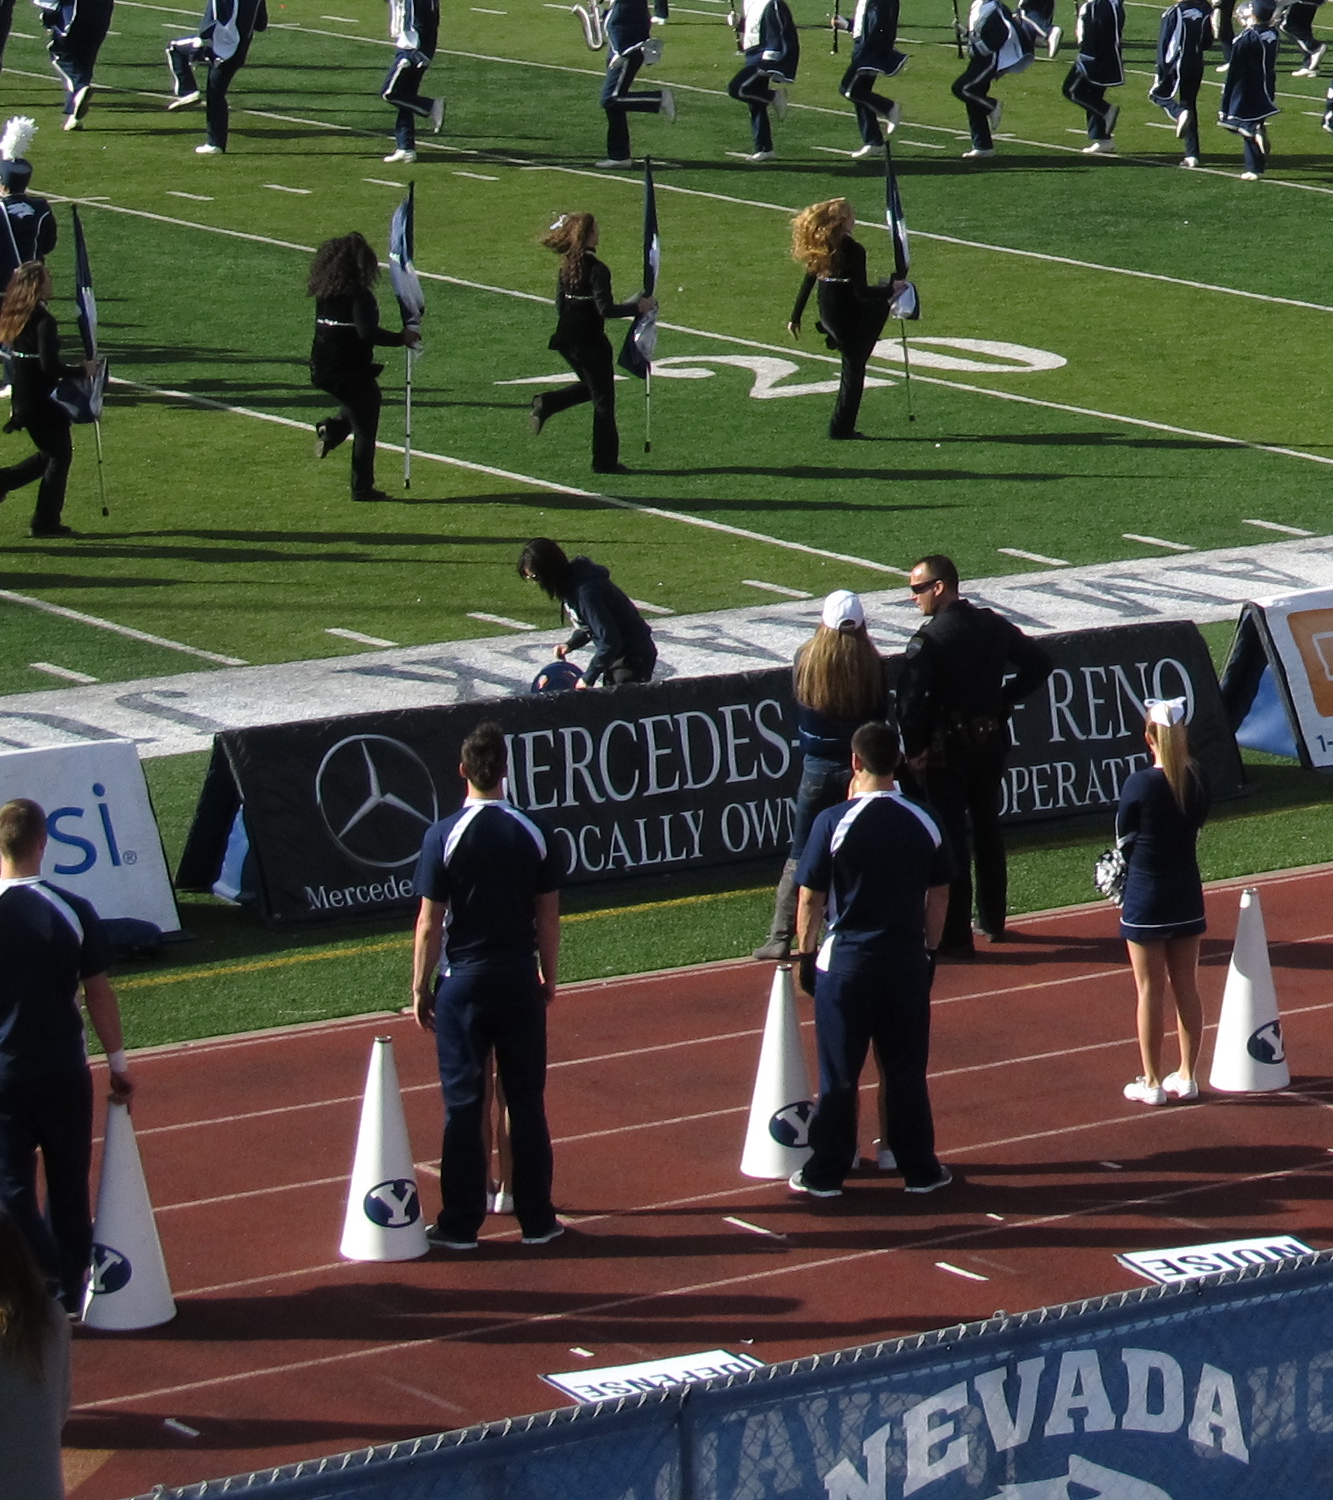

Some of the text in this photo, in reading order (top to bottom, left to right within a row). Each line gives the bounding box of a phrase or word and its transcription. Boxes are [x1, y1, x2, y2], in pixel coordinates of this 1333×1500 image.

[645, 336, 1068, 399] 20
[504, 698, 801, 813] ERCEDES-
[1046, 658, 1195, 744] RENO
[721, 799, 800, 854] OWN
[1000, 751, 1150, 817] PERAT
[304, 872, 418, 910] Mercede
[1255, 1024, 1286, 1061] Y
[776, 1104, 817, 1147] Y
[371, 1182, 418, 1227] Y
[824, 1347, 1251, 1500] NEVADA
